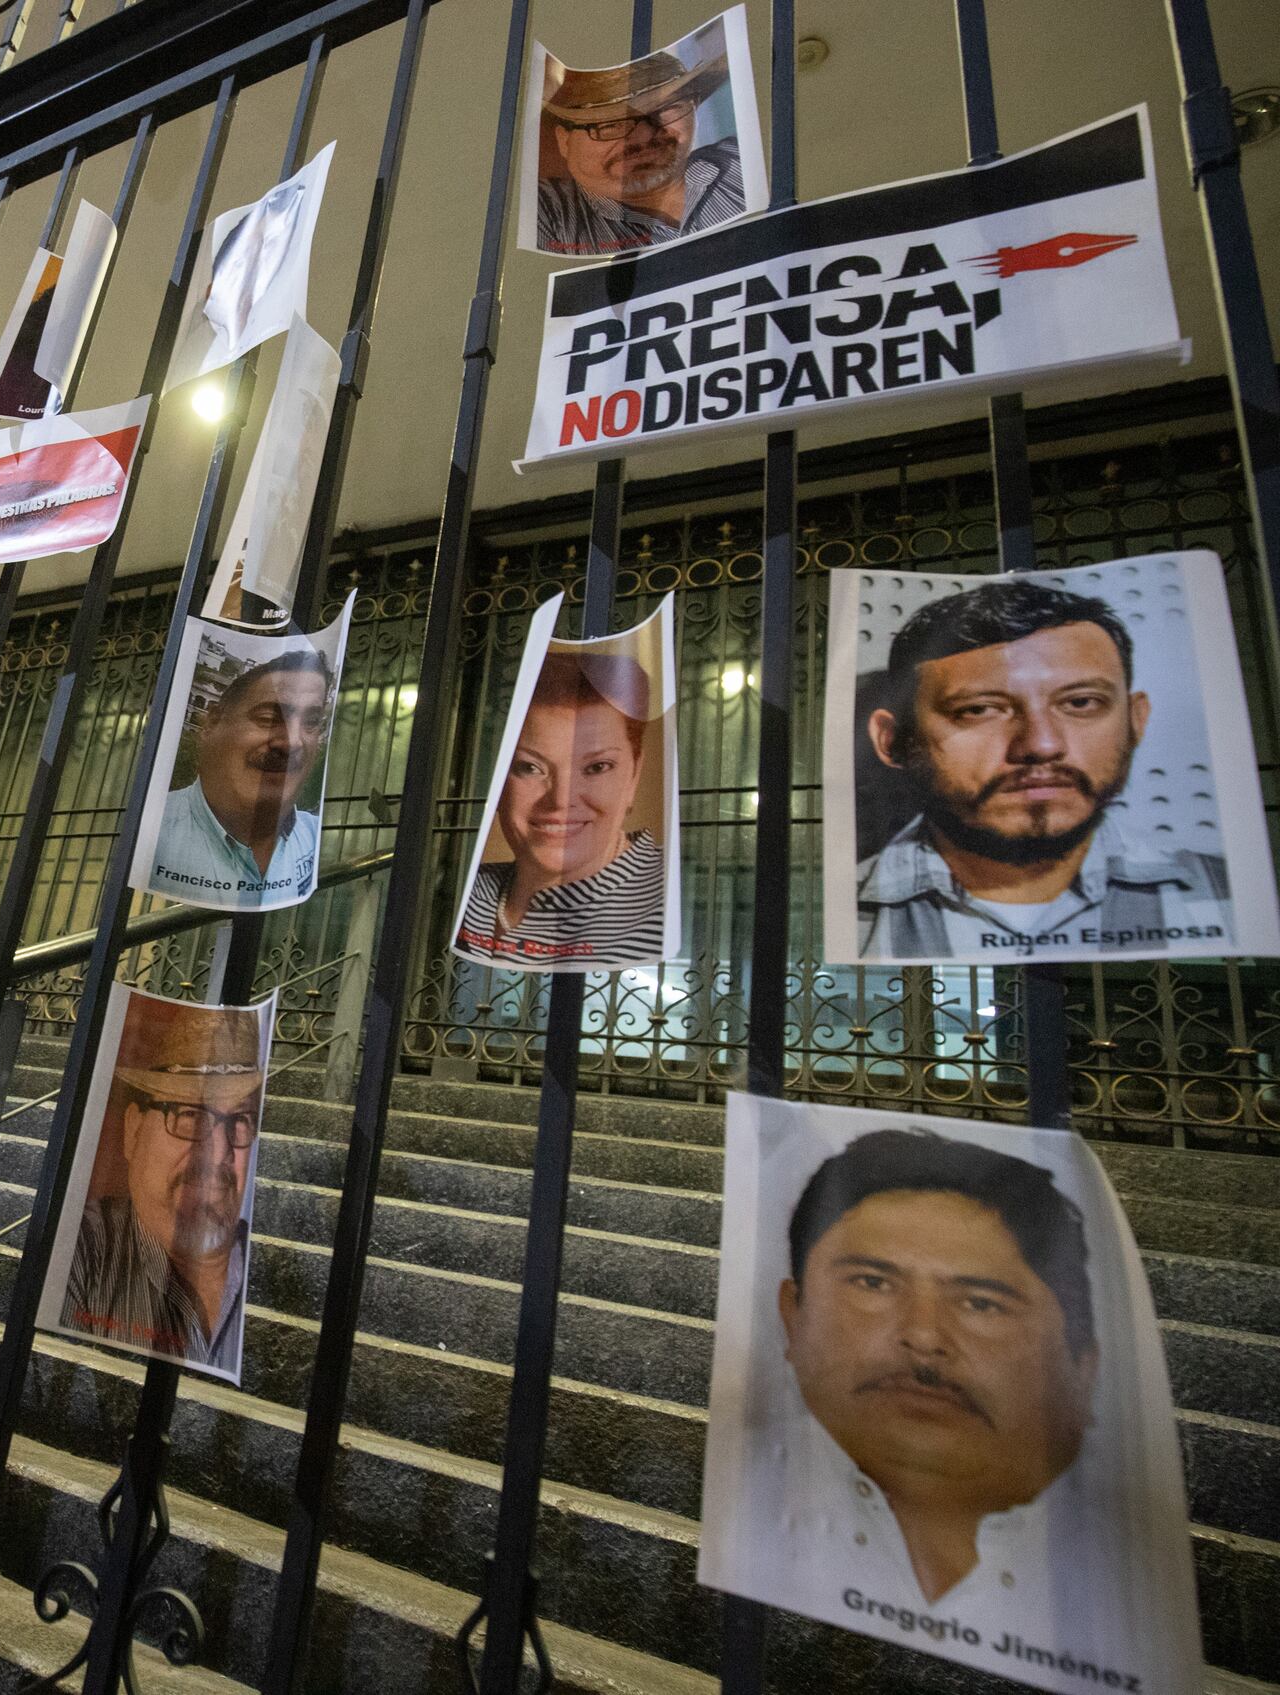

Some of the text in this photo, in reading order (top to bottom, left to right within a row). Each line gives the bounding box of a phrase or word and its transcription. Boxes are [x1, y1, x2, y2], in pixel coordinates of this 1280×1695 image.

[555, 243, 1002, 394] PRENSA,
[156, 865, 292, 892] Francisco Pacheco
[1081, 923, 1224, 949] Espinosa
[842, 1587, 981, 1647] Gregorio
